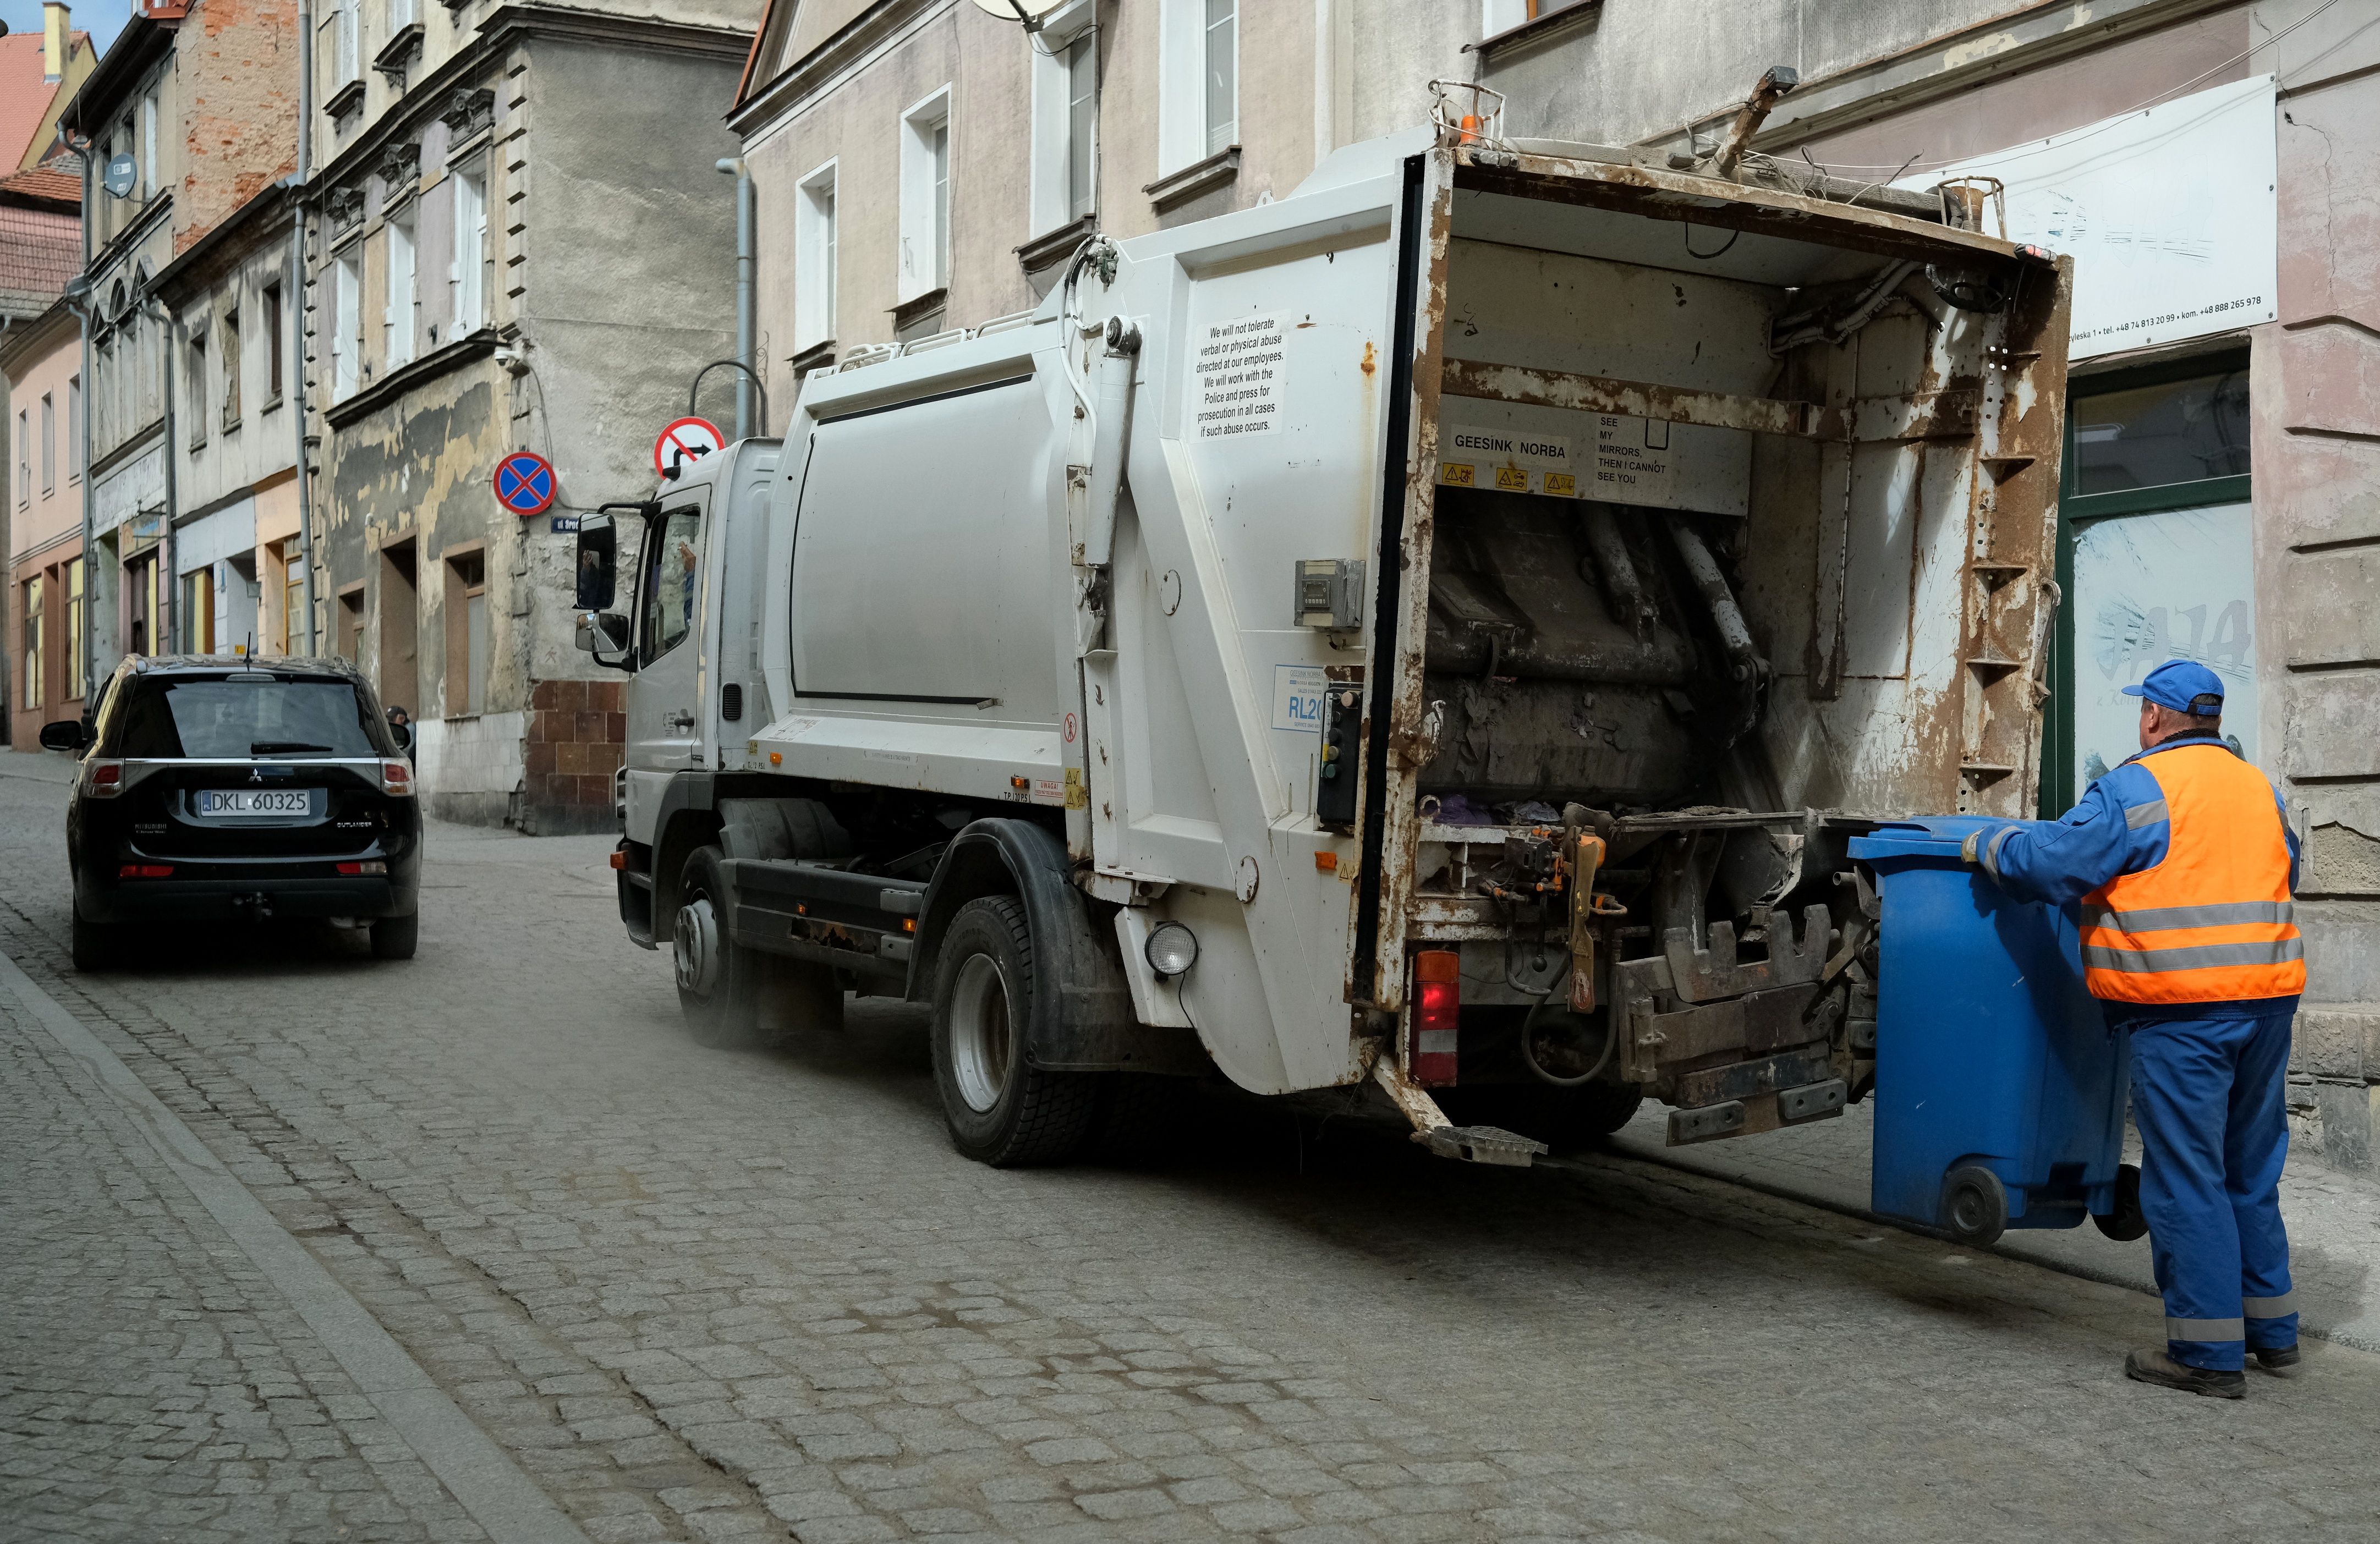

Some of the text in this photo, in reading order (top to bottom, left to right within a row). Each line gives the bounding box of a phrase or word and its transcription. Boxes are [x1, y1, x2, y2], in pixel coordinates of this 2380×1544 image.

[2103, 326, 2114, 335] tel.
[2116, 323, 2129, 332] +48
[2141, 318, 2154, 327] 813
[2156, 316, 2165, 325] 20
[2166, 314, 2175, 322] 99
[2181, 309, 2198, 319] kom.
[2200, 306, 2213, 315] +48
[2215, 303, 2229, 312] 888
[2231, 300, 2244, 309] 265
[2246, 296, 2262, 306] 978
[1210, 318, 1274, 339] We will not tolerate
[1200, 334, 1282, 356] verbal or physical abuse
[1196, 352, 1283, 373] directed at our employees.
[1204, 368, 1273, 388] We will work with the
[1205, 385, 1270, 404] Police and press for
[1198, 406, 1235, 424] prosecution
[1238, 406, 1243, 416] in
[1255, 403, 1275, 414] cases
[1600, 417, 1618, 427] SEE
[1201, 421, 1269, 437] if such abuse occurs.
[1600, 430, 1613, 440] MY
[1455, 434, 1566, 459] GEESINK NORBA
[1599, 444, 1642, 458] MIRRORS,
[1598, 457, 1665, 474] THEN I CANNOT
[1597, 471, 1636, 484] SEE YOU
[212, 794, 306, 810] DKL 60325
